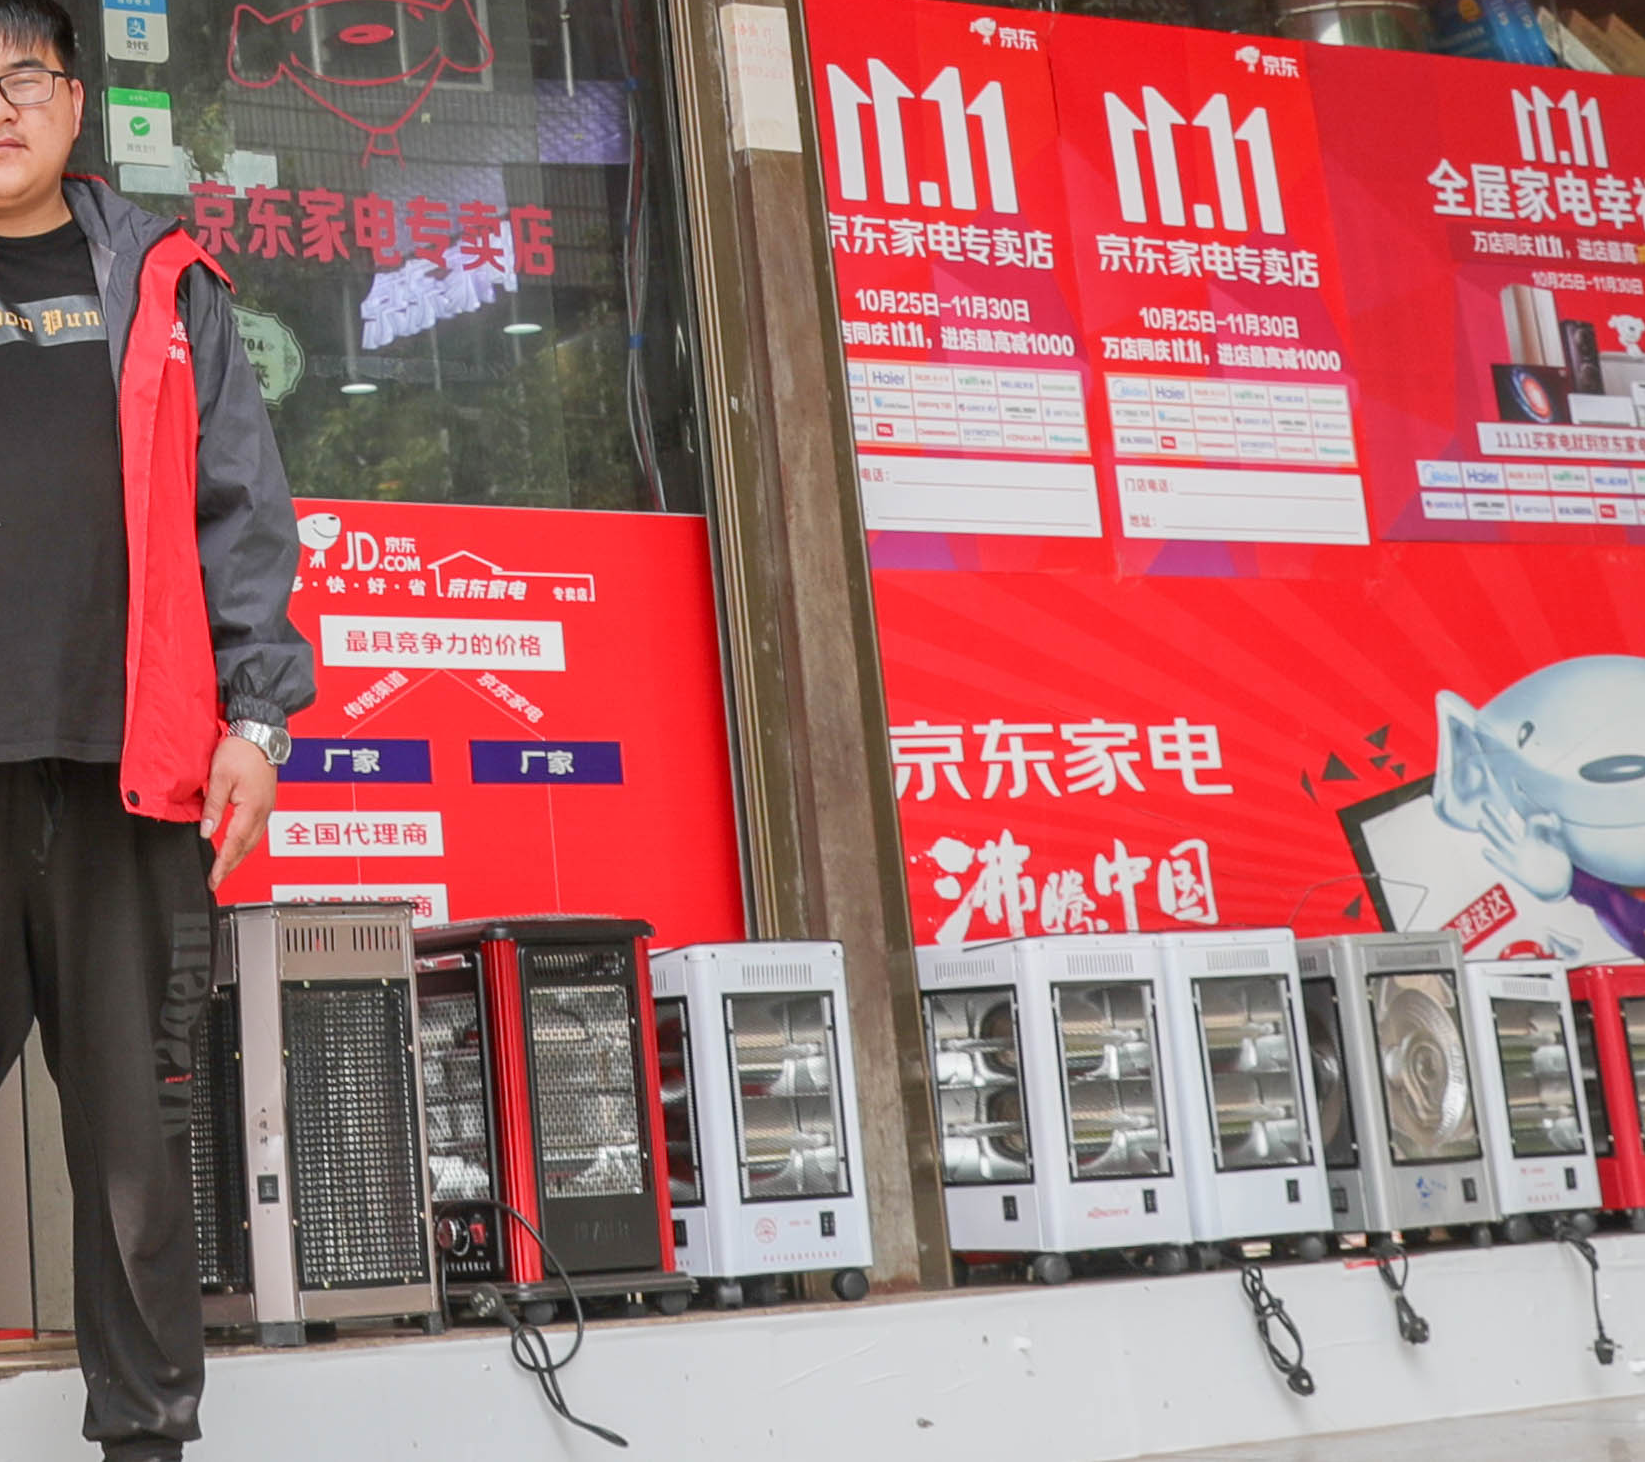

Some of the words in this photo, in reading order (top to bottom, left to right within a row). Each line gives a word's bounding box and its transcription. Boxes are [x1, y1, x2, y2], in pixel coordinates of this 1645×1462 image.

[998, 26, 1039, 51] 京东
[1261, 54, 1300, 79] 京东
[826, 57, 1020, 215] 11.11
[1511, 85, 1609, 169] 11.11
[1102, 85, 1287, 236] 11.11
[188, 179, 556, 276] 京东家电专卖店
[1095, 233, 1320, 289] 京东家电专卖店
[384, 536, 417, 554] 京东
[446, 578, 528, 601] 京东家电
[345, 630, 543, 658] 最具竞争力的价格
[342, 670, 411, 721] 传统渠道
[476, 671, 545, 725] 京东家电
[323, 748, 381, 774] 厂家
[520, 749, 575, 776] 厂家
[889, 715, 1235, 803] 京东家电
[284, 822, 429, 846] 全国代理商
